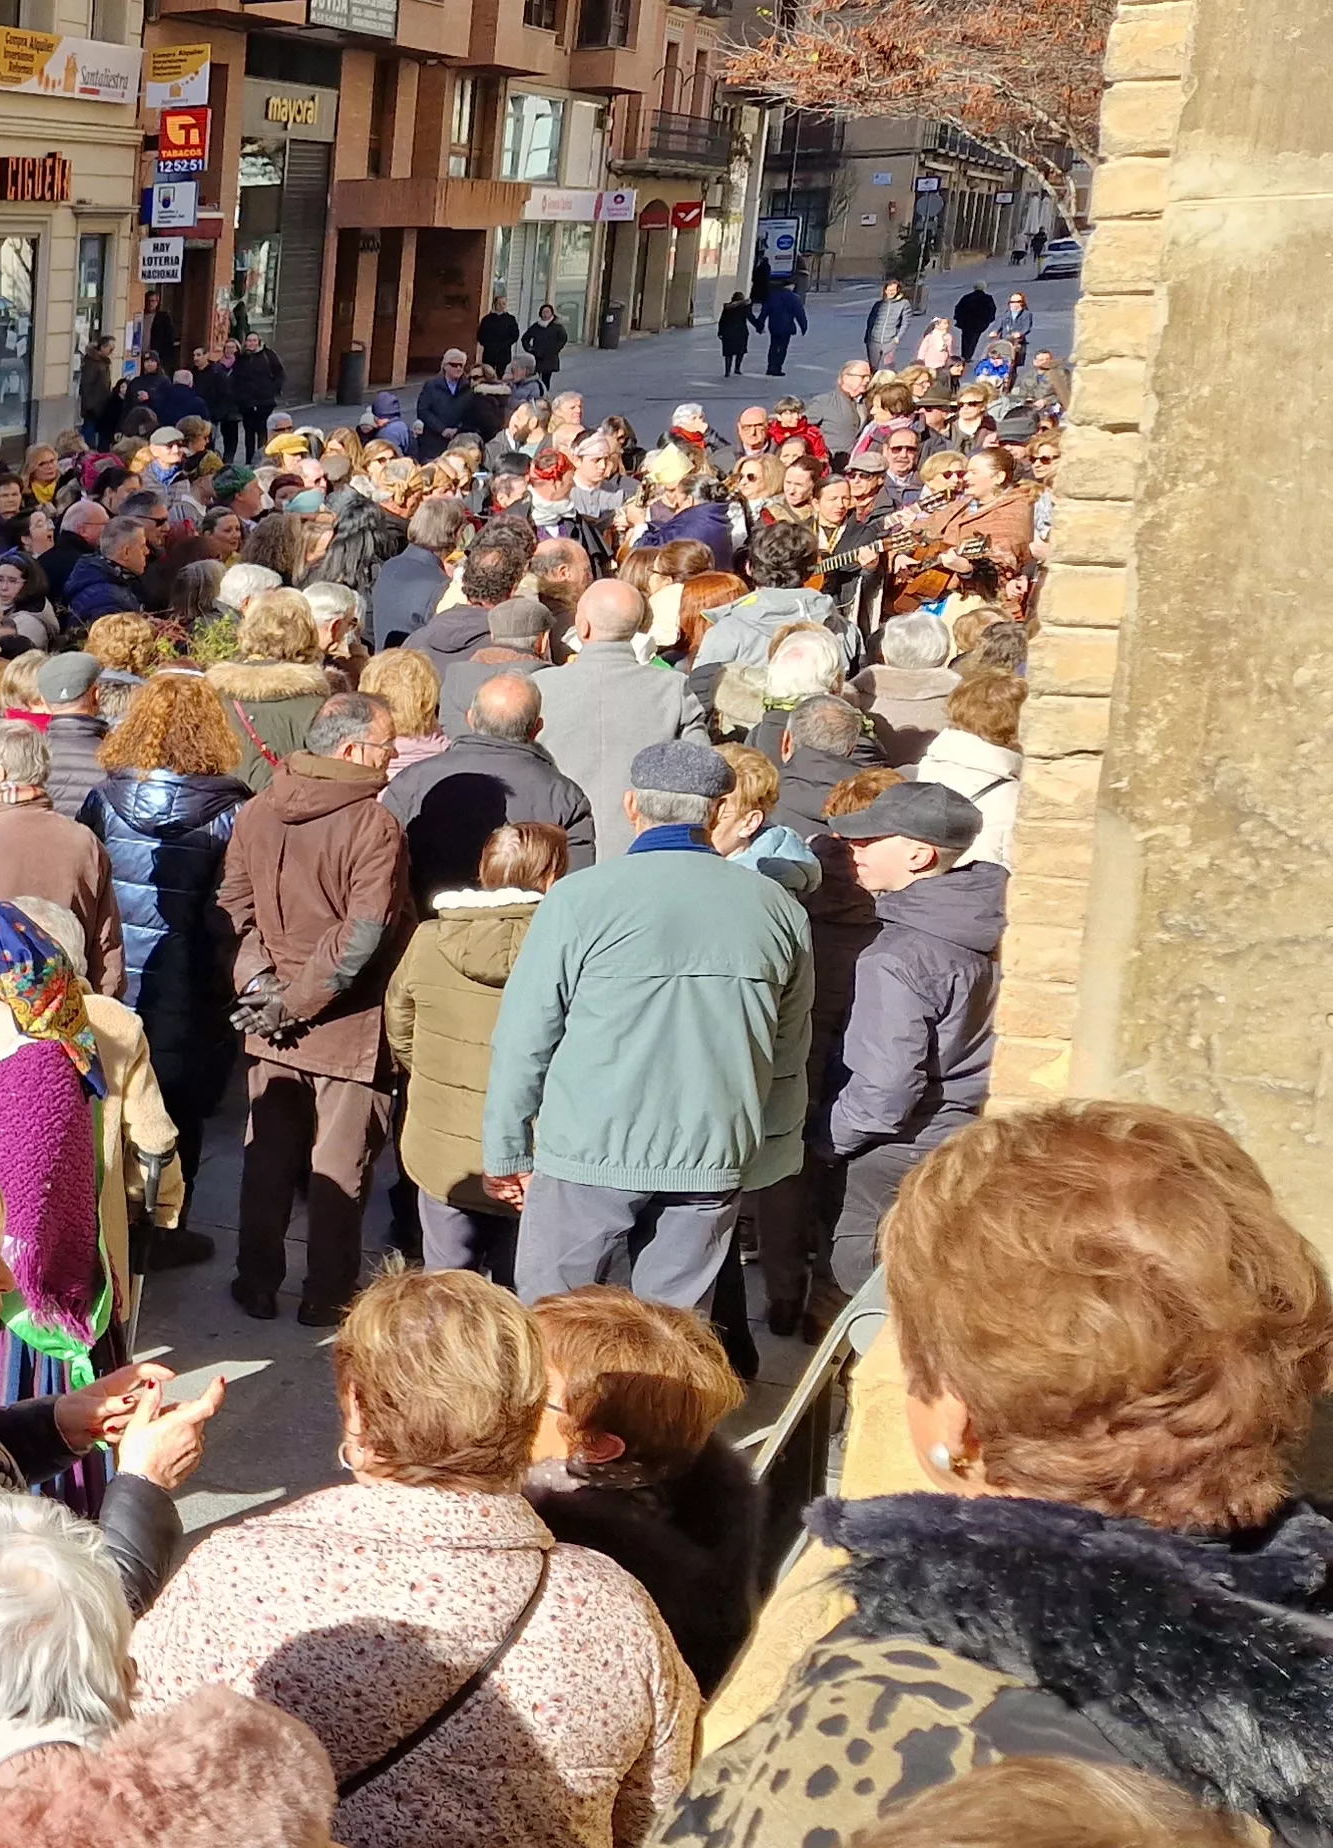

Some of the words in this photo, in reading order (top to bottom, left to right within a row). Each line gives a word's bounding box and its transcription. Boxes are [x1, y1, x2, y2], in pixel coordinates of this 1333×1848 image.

[80, 65, 130, 90] Santaliestra
[266, 93, 320, 132] mayoral
[161, 148, 203, 158] TABACOS
[153, 242, 171, 253] HAY
[142, 255, 180, 267] LOTERIA
[141, 269, 179, 281] NACIONAL
